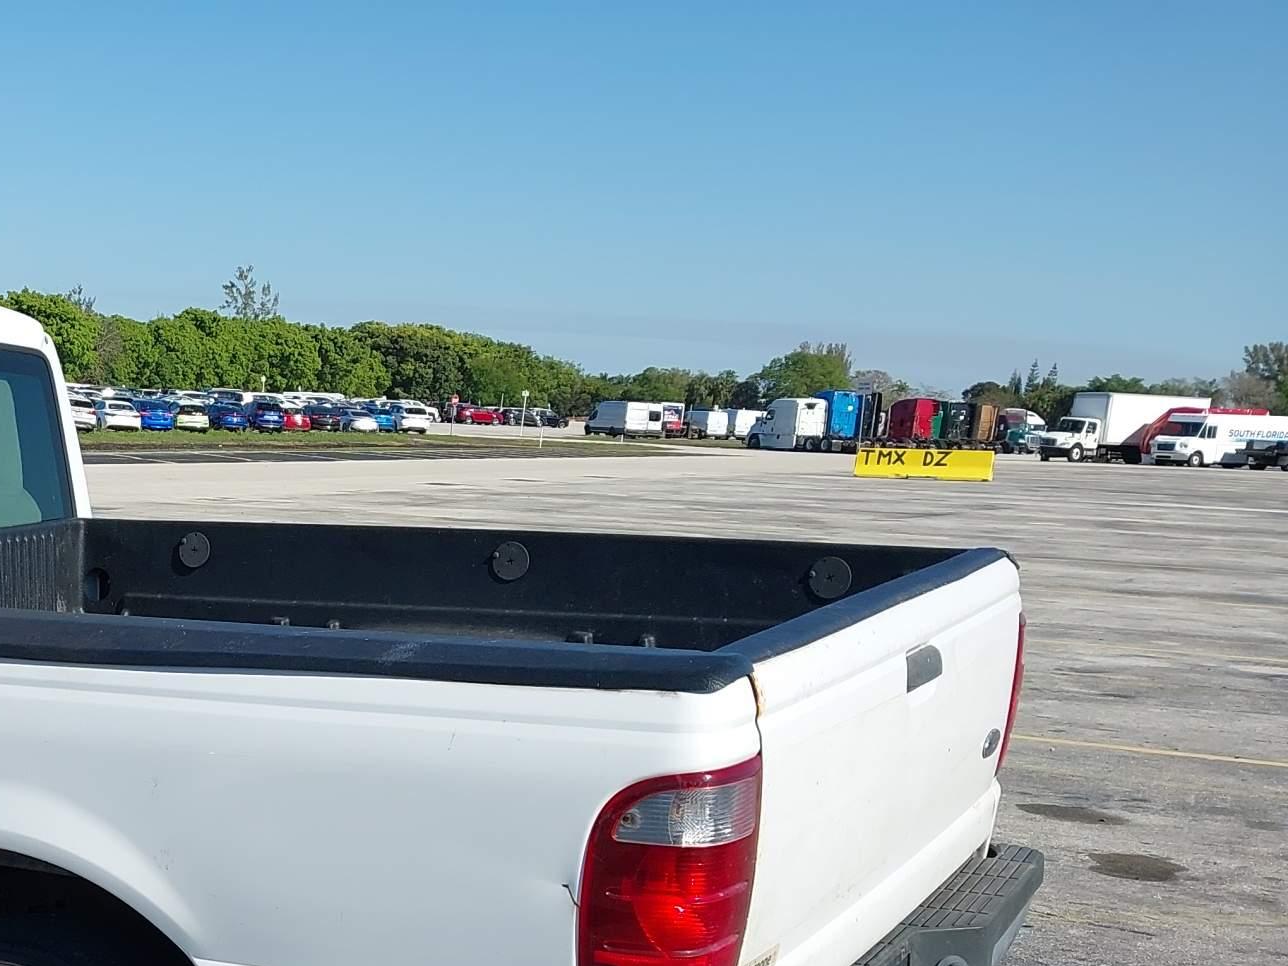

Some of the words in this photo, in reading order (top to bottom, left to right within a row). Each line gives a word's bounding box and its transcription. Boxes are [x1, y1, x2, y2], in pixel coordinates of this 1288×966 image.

[1228, 429, 1255, 438] SOUTH
[860, 449, 907, 466] TMX
[922, 451, 953, 467] DZ
